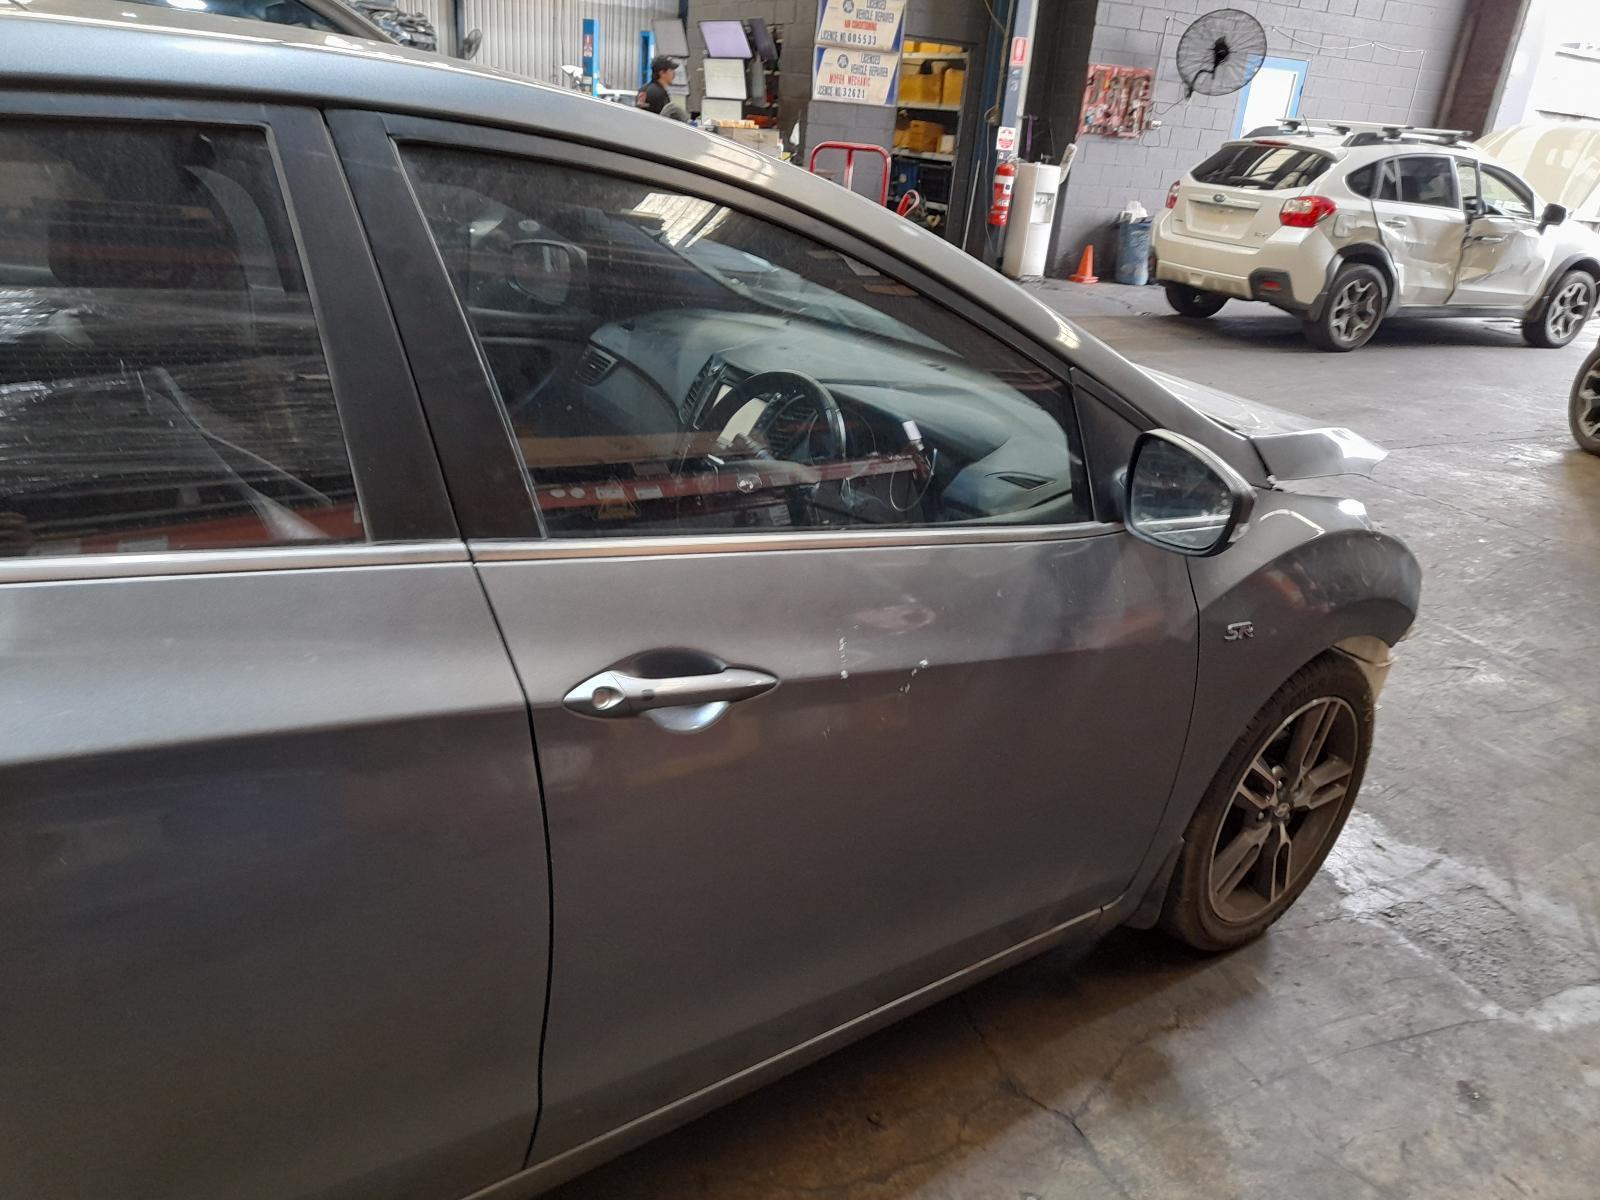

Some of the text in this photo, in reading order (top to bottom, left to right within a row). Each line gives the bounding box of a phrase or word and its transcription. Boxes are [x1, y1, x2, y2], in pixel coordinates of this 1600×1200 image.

[856, 9, 873, 20] VEHICLE
[851, 64, 867, 75] VEHICLE
[829, 73, 871, 87] MOTOR MECHANIC
[843, 87, 865, 99] 32621
[1224, 621, 1254, 640] SR
